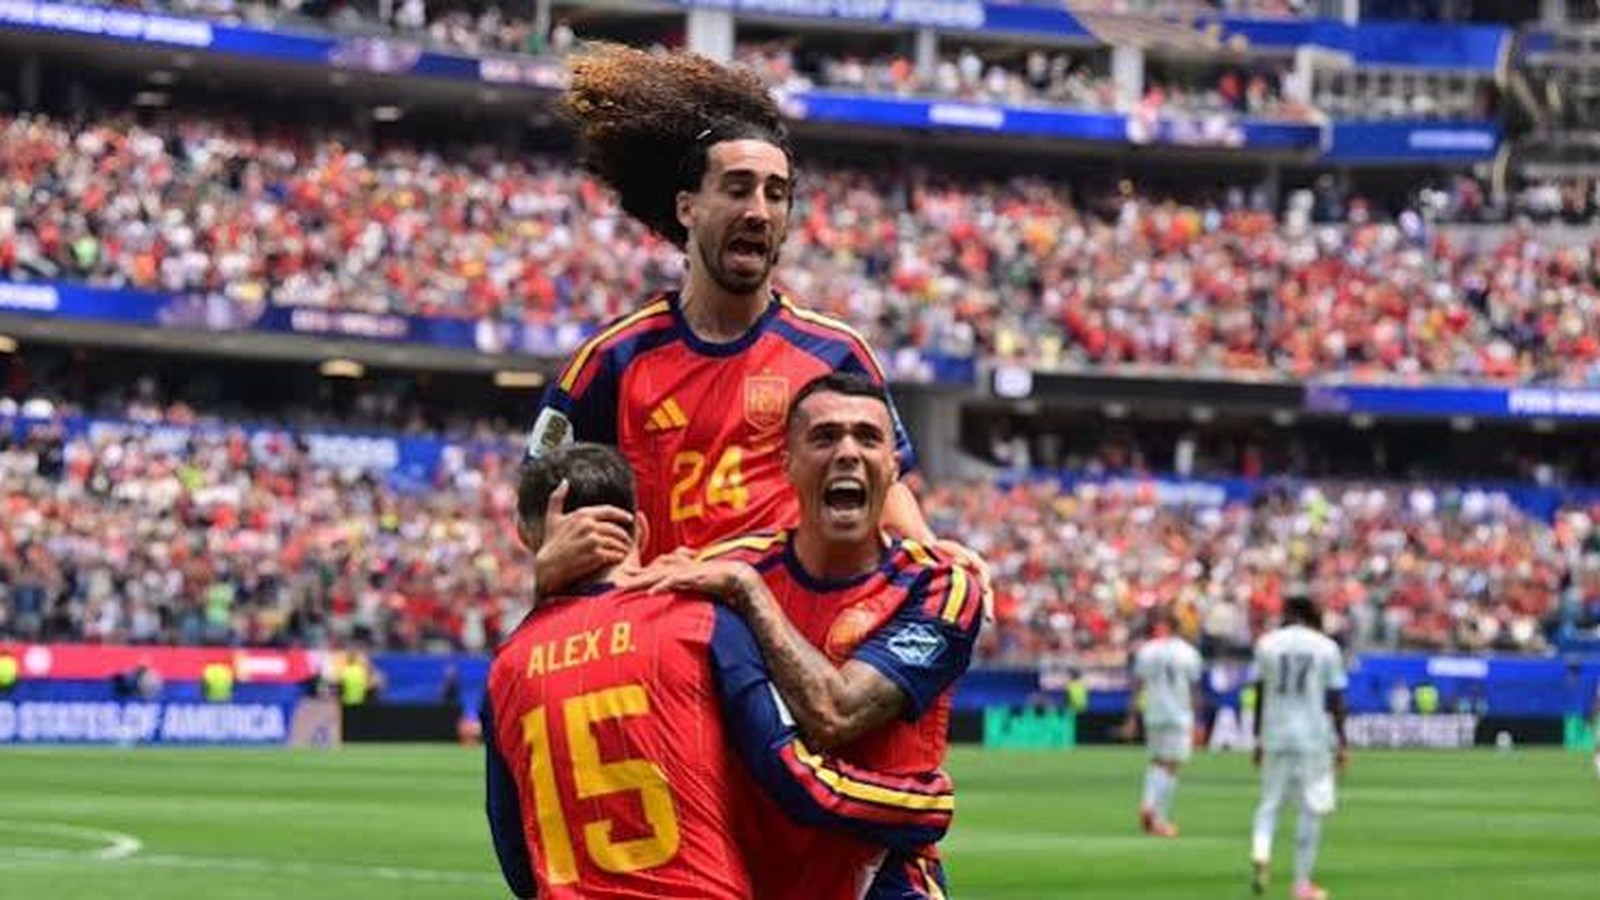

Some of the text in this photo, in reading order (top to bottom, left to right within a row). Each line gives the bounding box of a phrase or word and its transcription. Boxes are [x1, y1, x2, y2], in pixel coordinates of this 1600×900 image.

[670, 446, 750, 522] 24
[527, 621, 637, 679] ALEX B.
[1278, 652, 1314, 694] 17
[163, 702, 286, 740] AMERICA
[520, 684, 681, 886] 15
